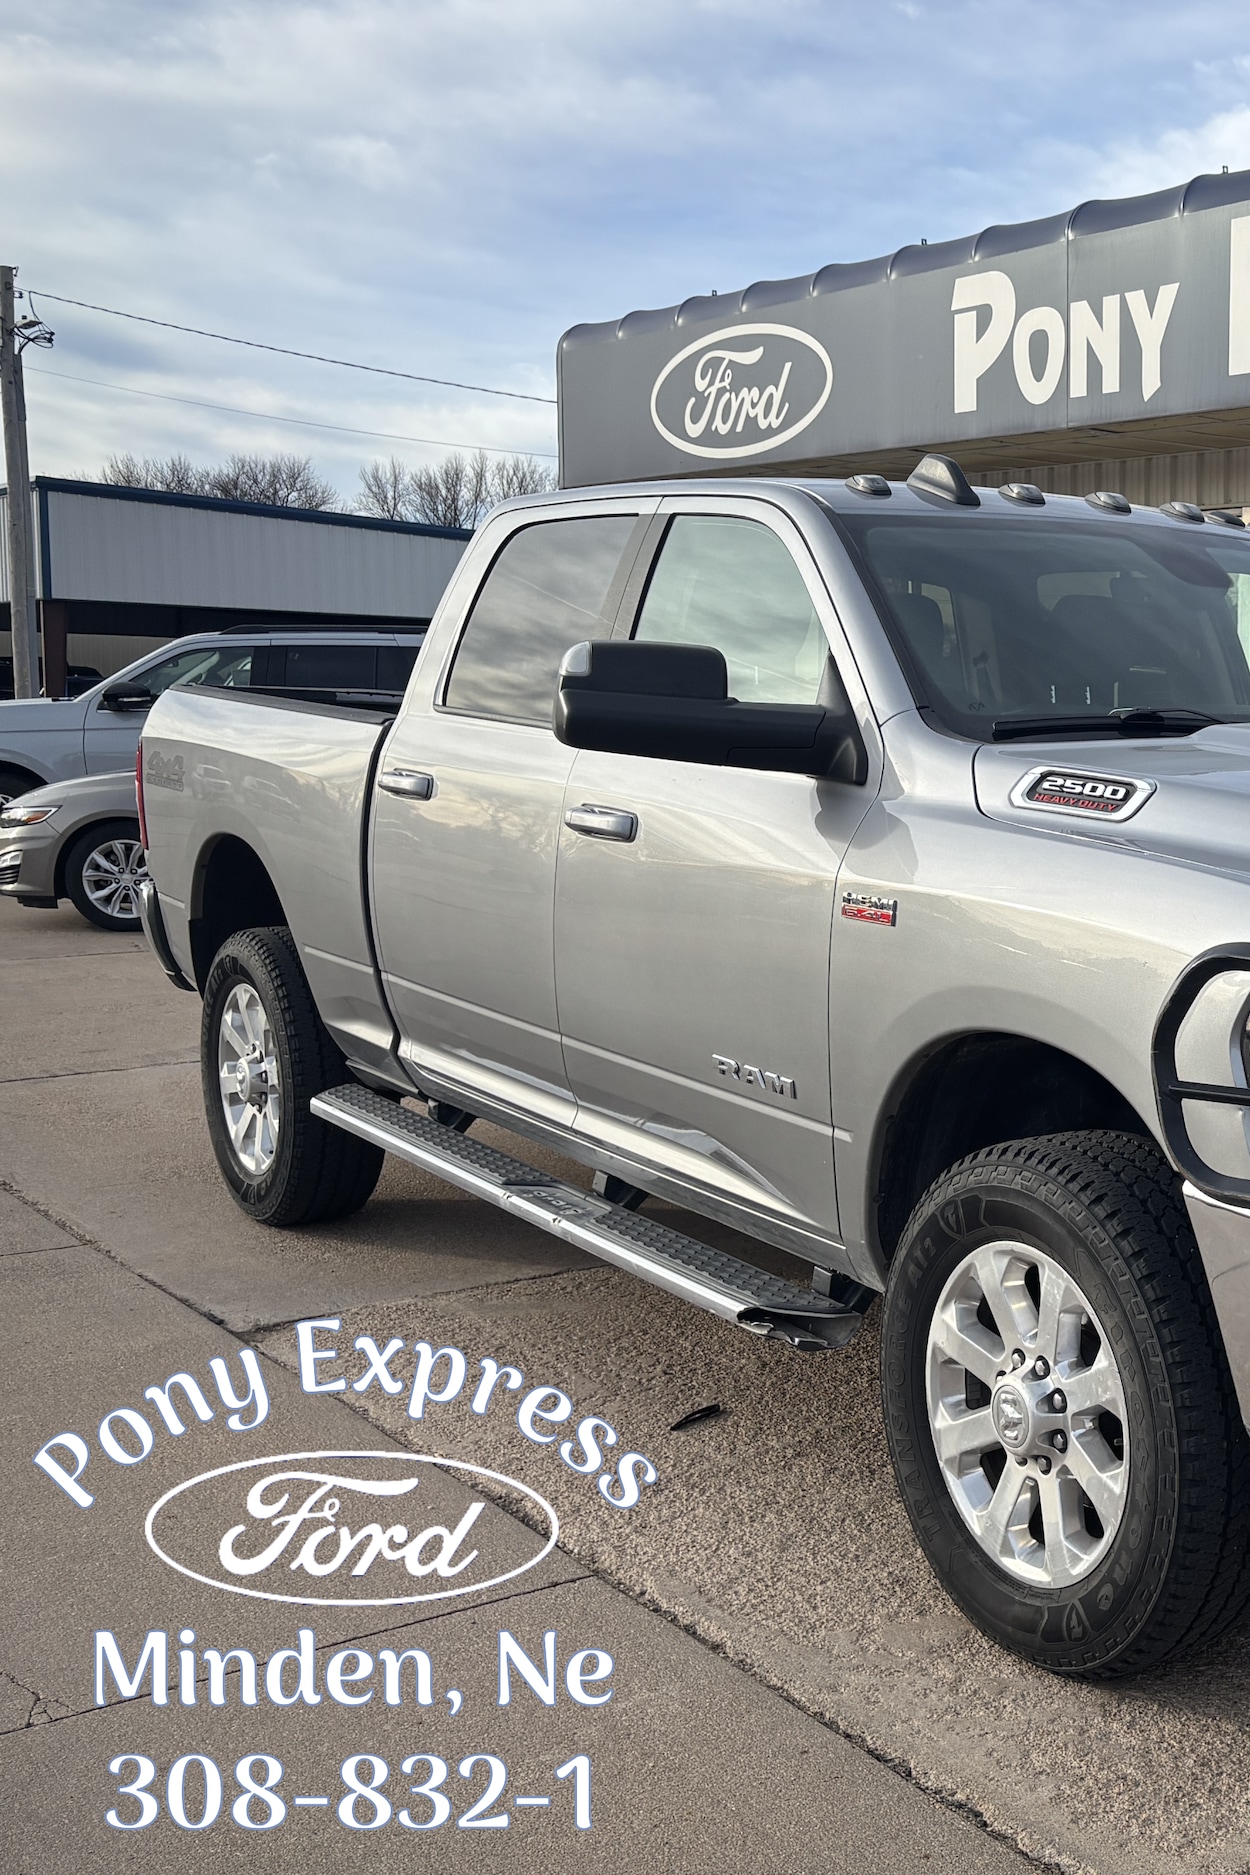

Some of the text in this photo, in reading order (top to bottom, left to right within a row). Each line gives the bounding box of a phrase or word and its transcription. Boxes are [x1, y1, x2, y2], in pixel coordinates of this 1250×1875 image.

[951, 270, 1180, 414] PONY
[685, 346, 792, 438] Ford
[1033, 793, 1120, 812] HEAVY DUTY
[1041, 776, 1127, 800] 2500
[712, 1053, 798, 1100] RAM
[907, 1236, 937, 1290] AT2
